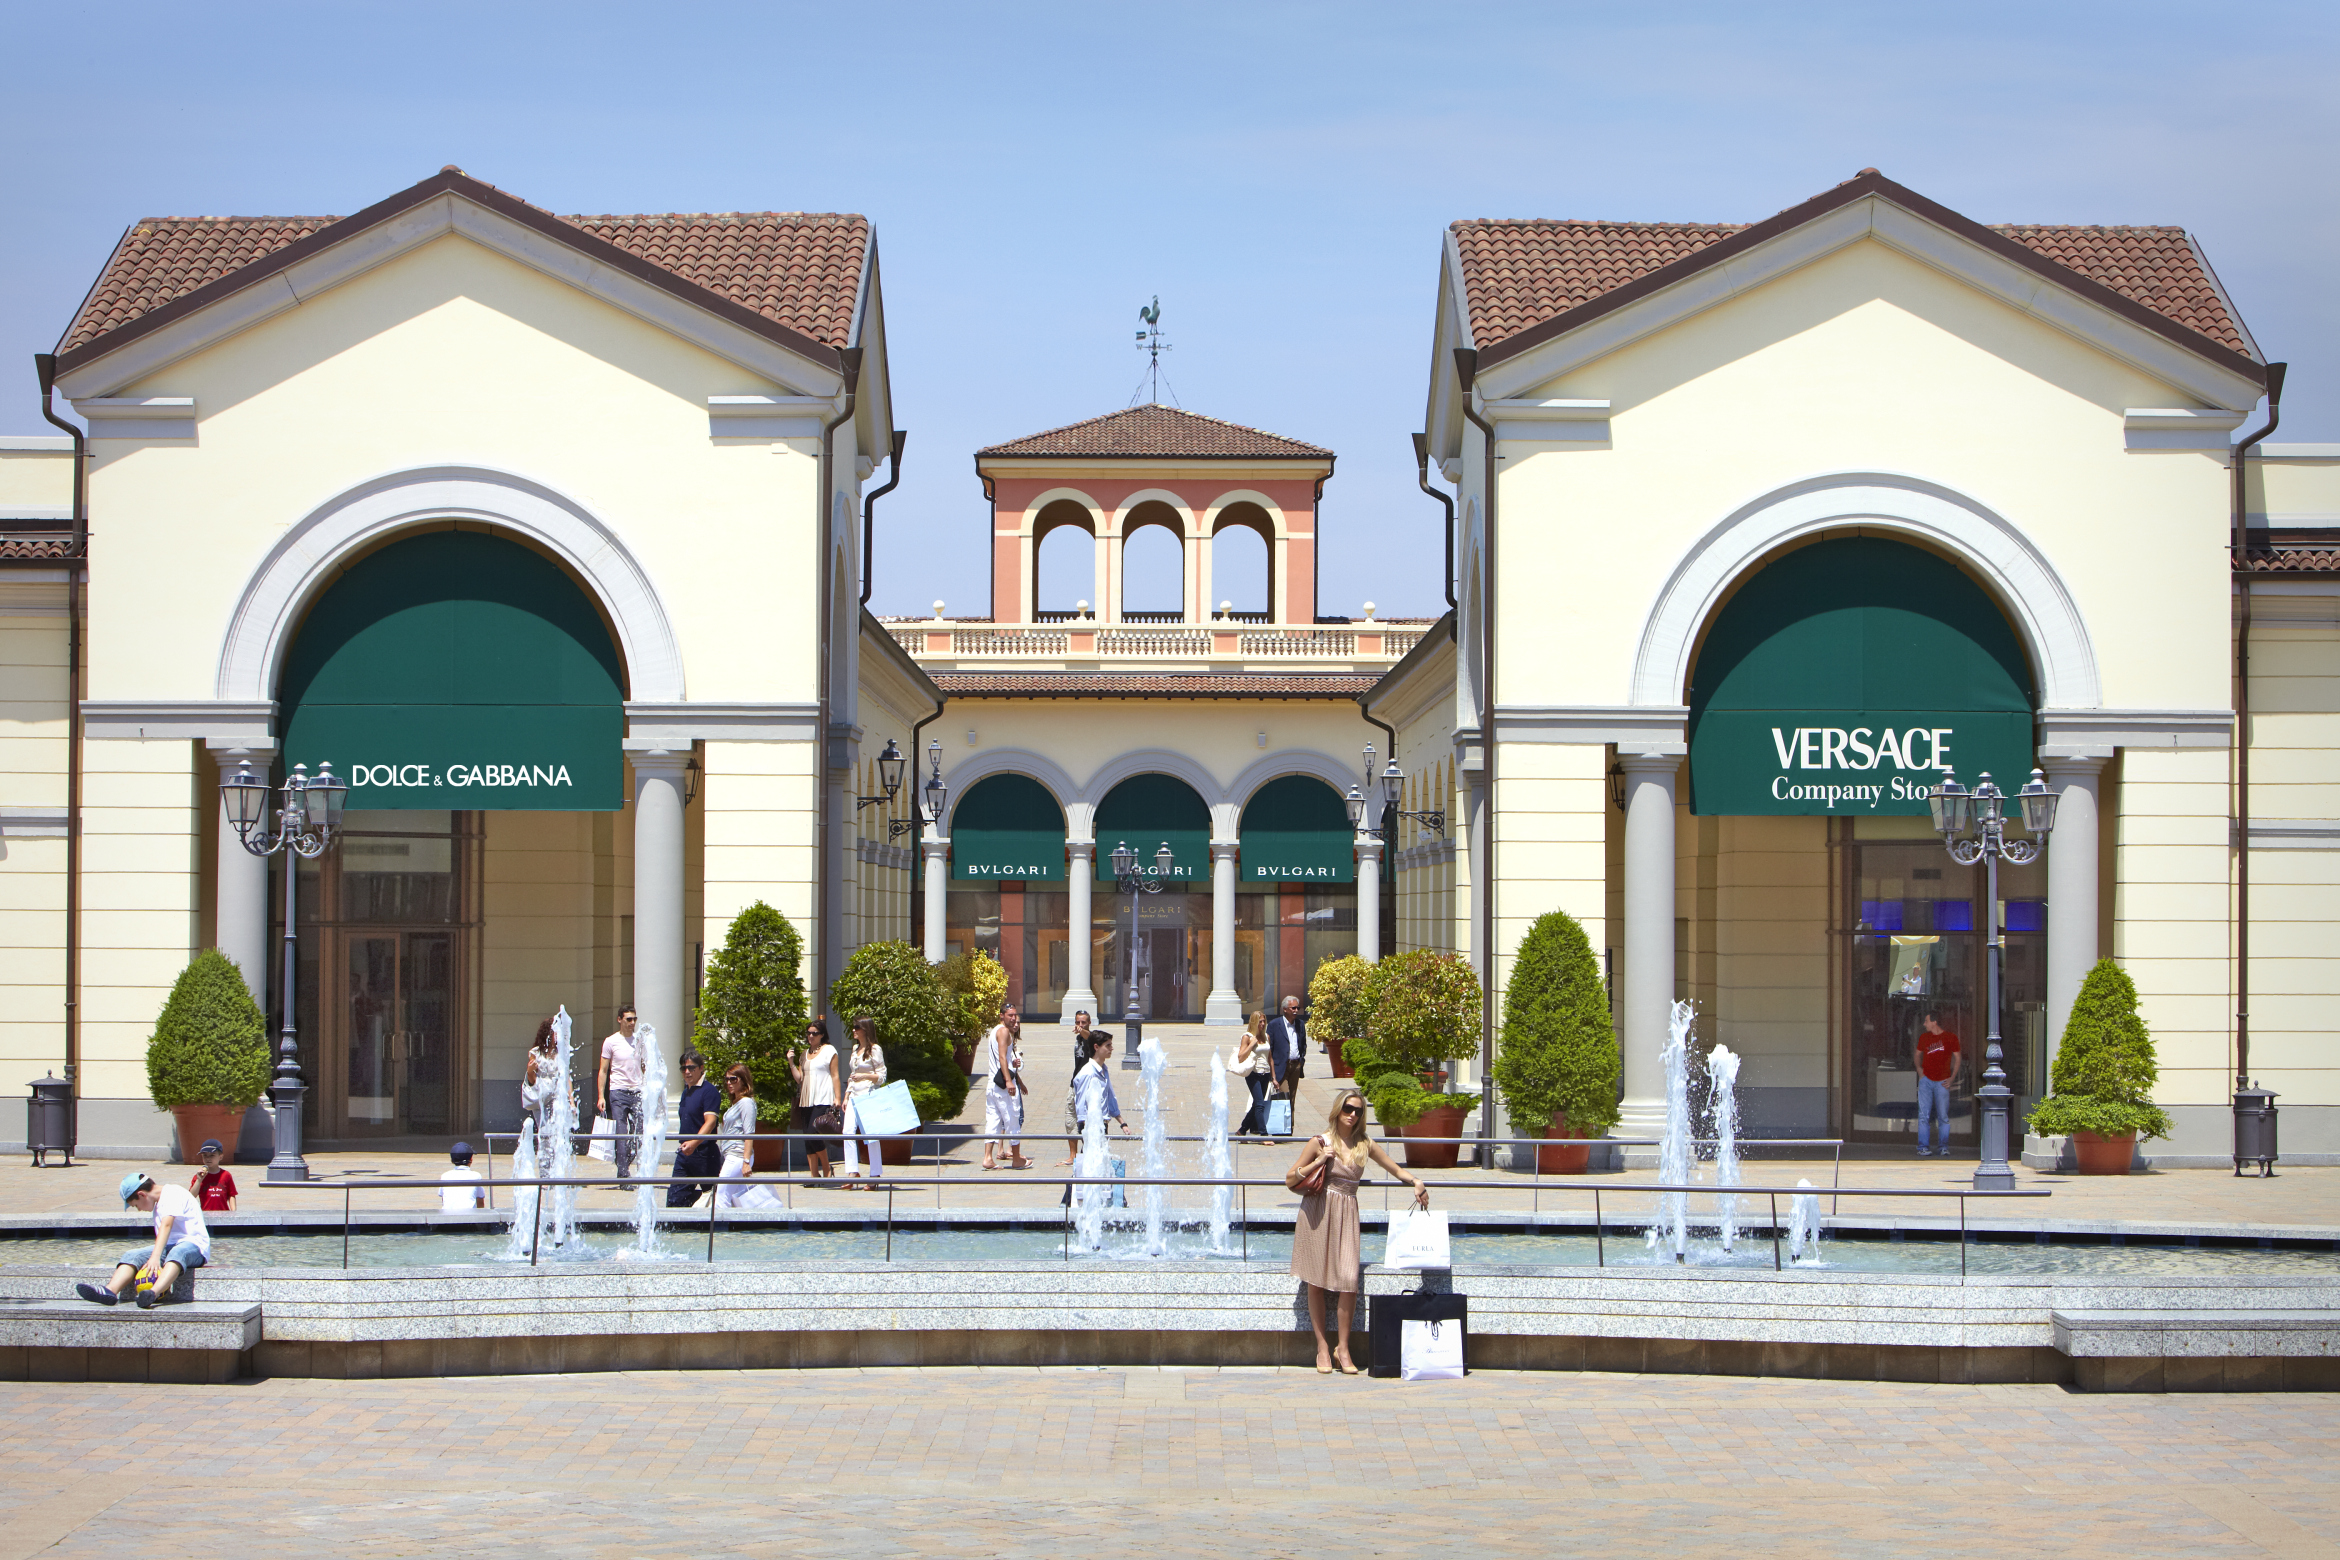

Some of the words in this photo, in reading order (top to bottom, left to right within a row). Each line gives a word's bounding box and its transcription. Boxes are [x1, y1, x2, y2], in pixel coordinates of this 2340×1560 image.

[1771, 727, 1953, 770] VERSACE
[352, 764, 430, 787] DOLCE
[433, 774, 443, 787] &
[446, 764, 573, 787] GABBANA
[1771, 776, 1884, 809] Company
[968, 864, 1047, 875] BVLGARI
[1257, 866, 1336, 877] BVLGARI
[1123, 905, 1181, 914] BLGARI
